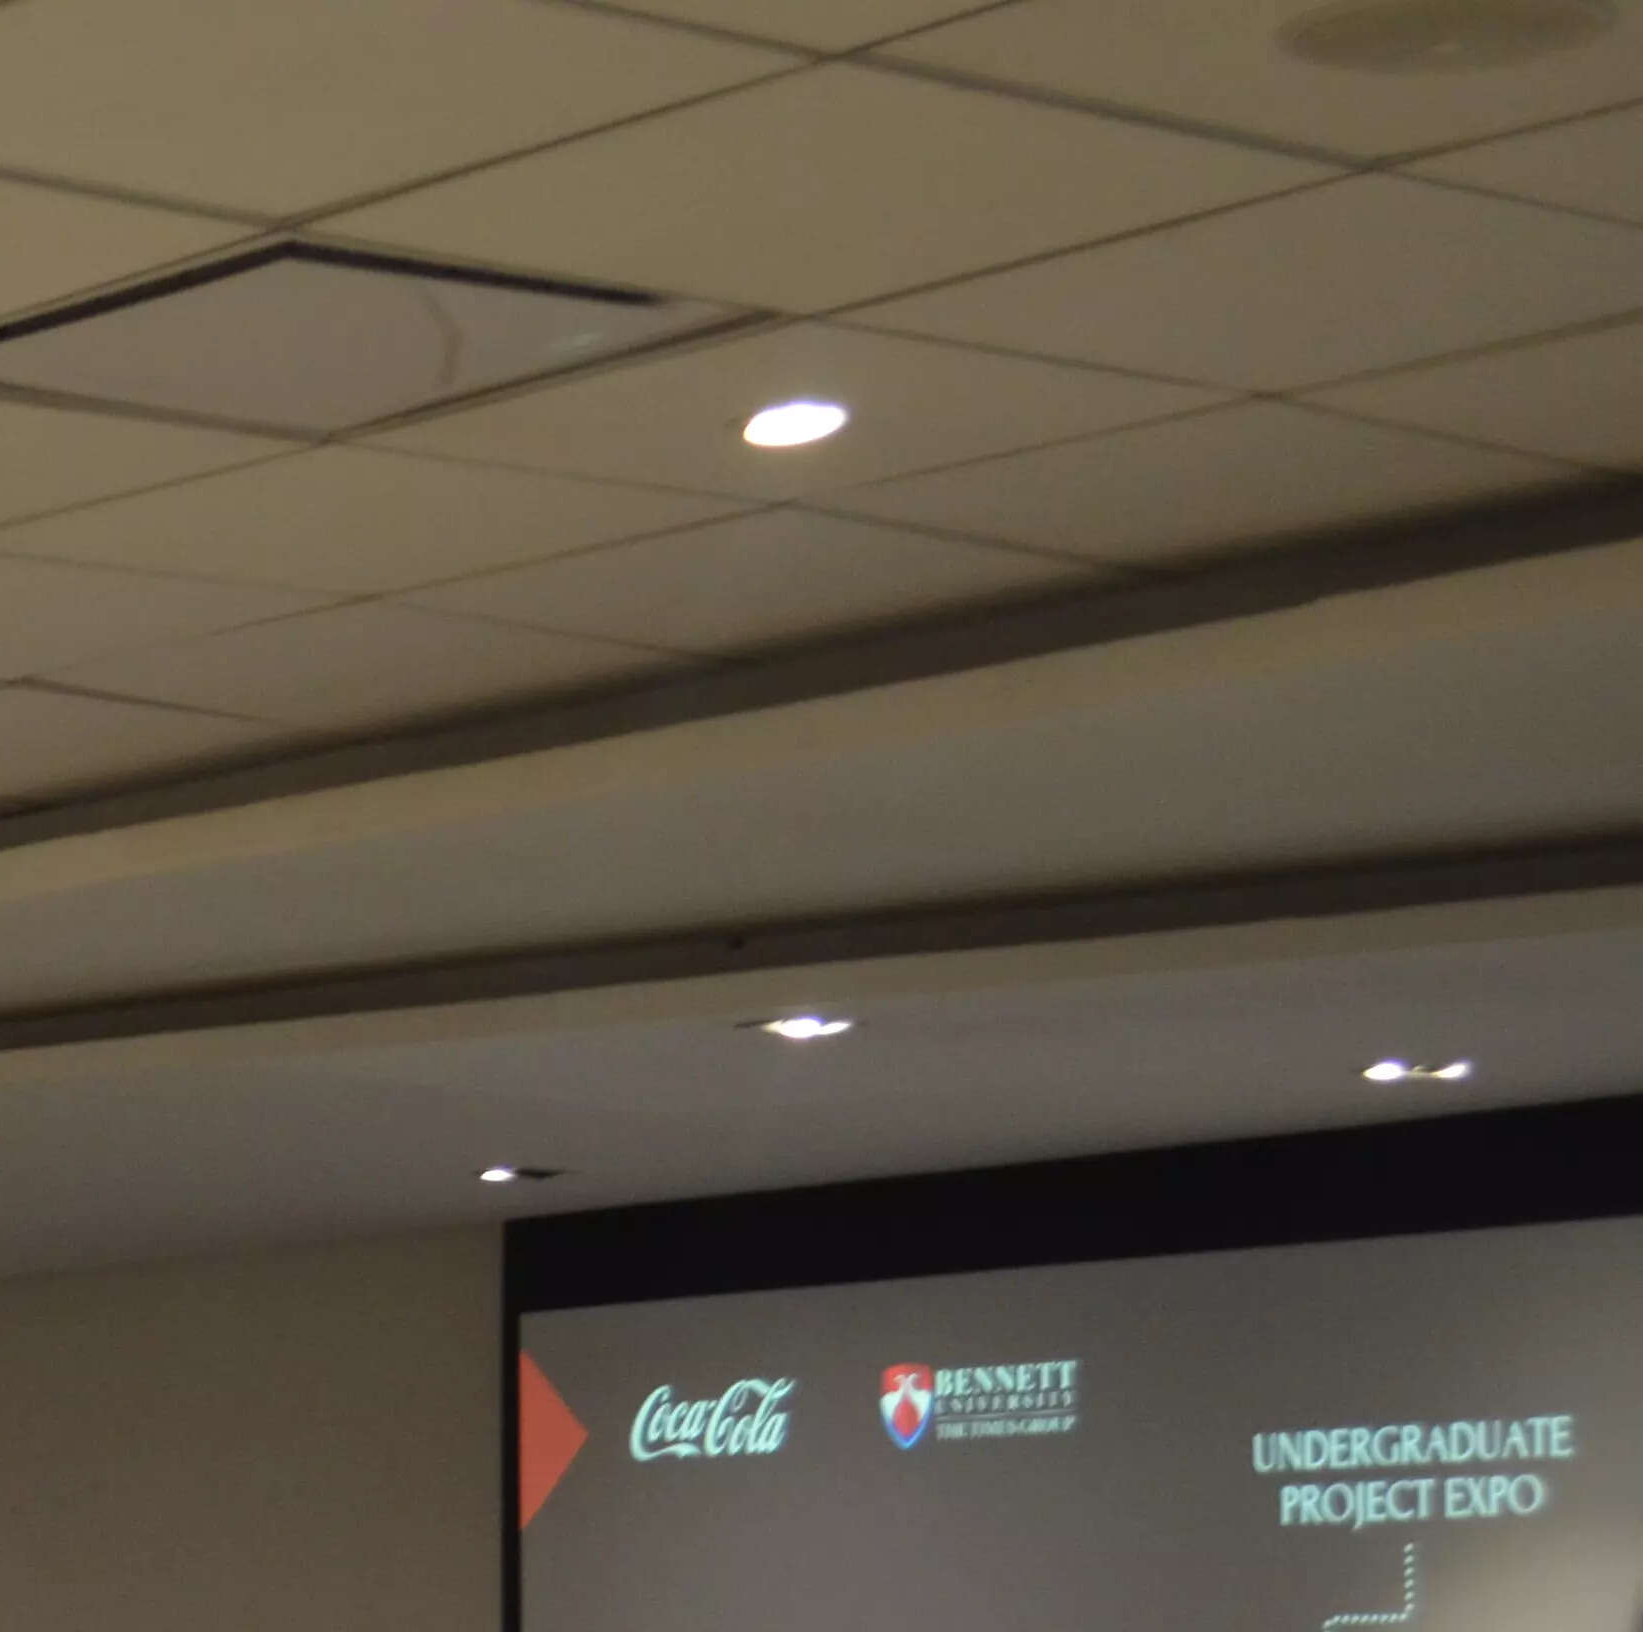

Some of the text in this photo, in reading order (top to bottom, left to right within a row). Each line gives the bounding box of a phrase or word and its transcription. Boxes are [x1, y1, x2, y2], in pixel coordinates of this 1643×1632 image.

[934, 1360, 1077, 1397] BENNETT
[1252, 1414, 1574, 1473] UNDERGRADUATE
[1280, 1474, 1544, 1532] PROJECT EXPO
